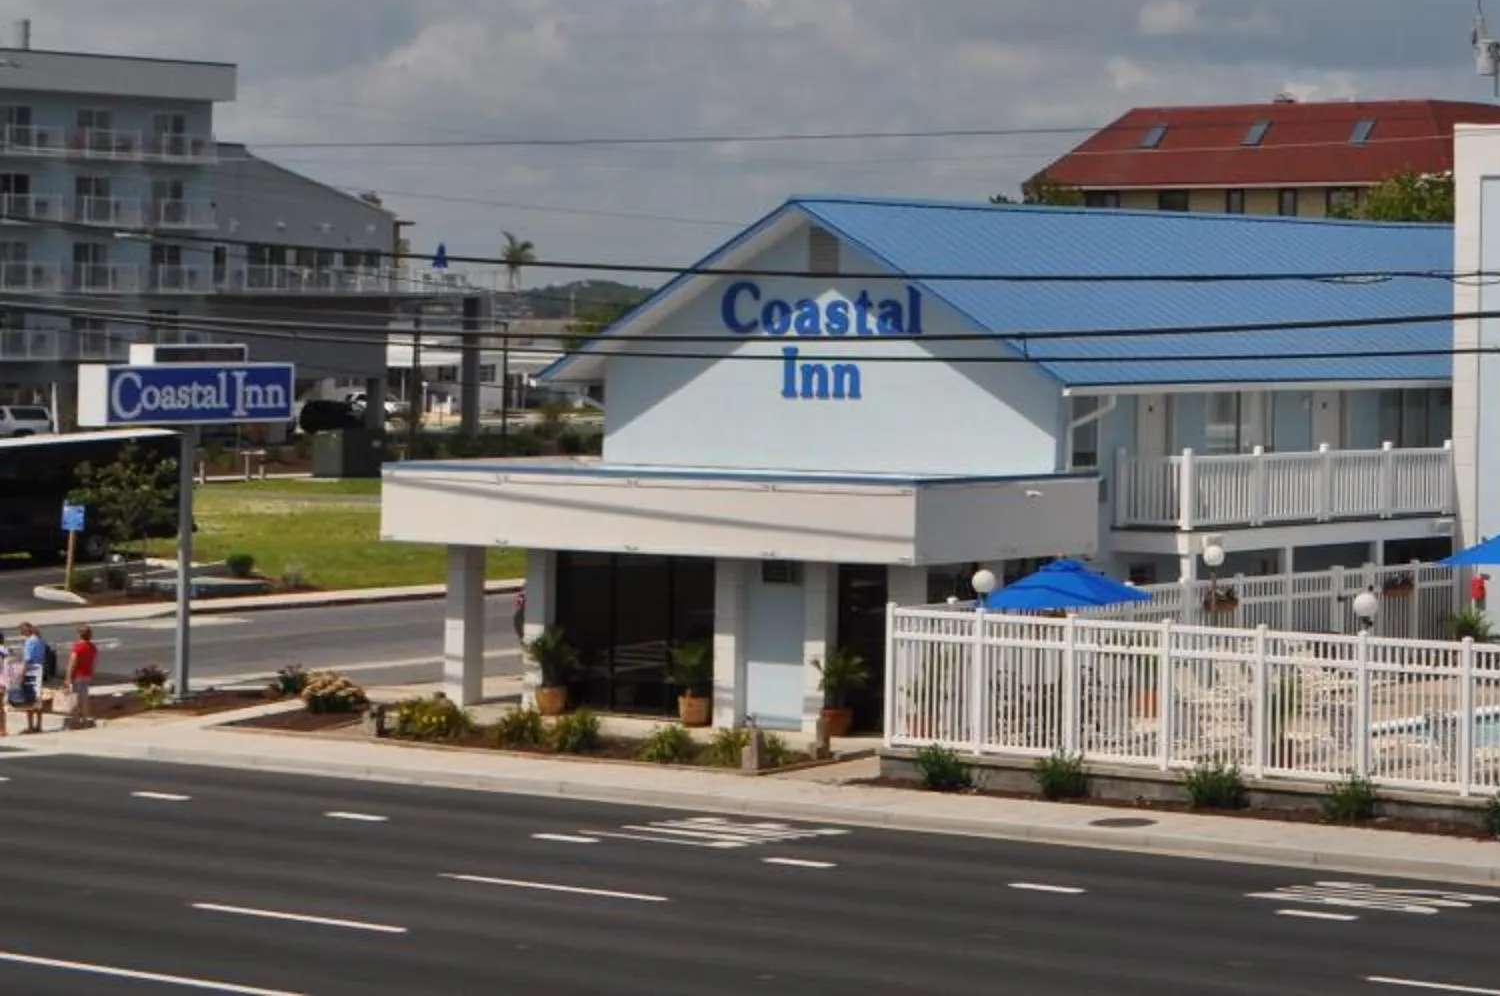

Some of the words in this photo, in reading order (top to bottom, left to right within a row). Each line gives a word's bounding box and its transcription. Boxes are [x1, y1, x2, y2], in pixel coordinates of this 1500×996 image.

[721, 281, 924, 335] Coastal
[111, 371, 227, 419] Coastal
[230, 370, 287, 417] Inn
[781, 346, 862, 400] Inn
